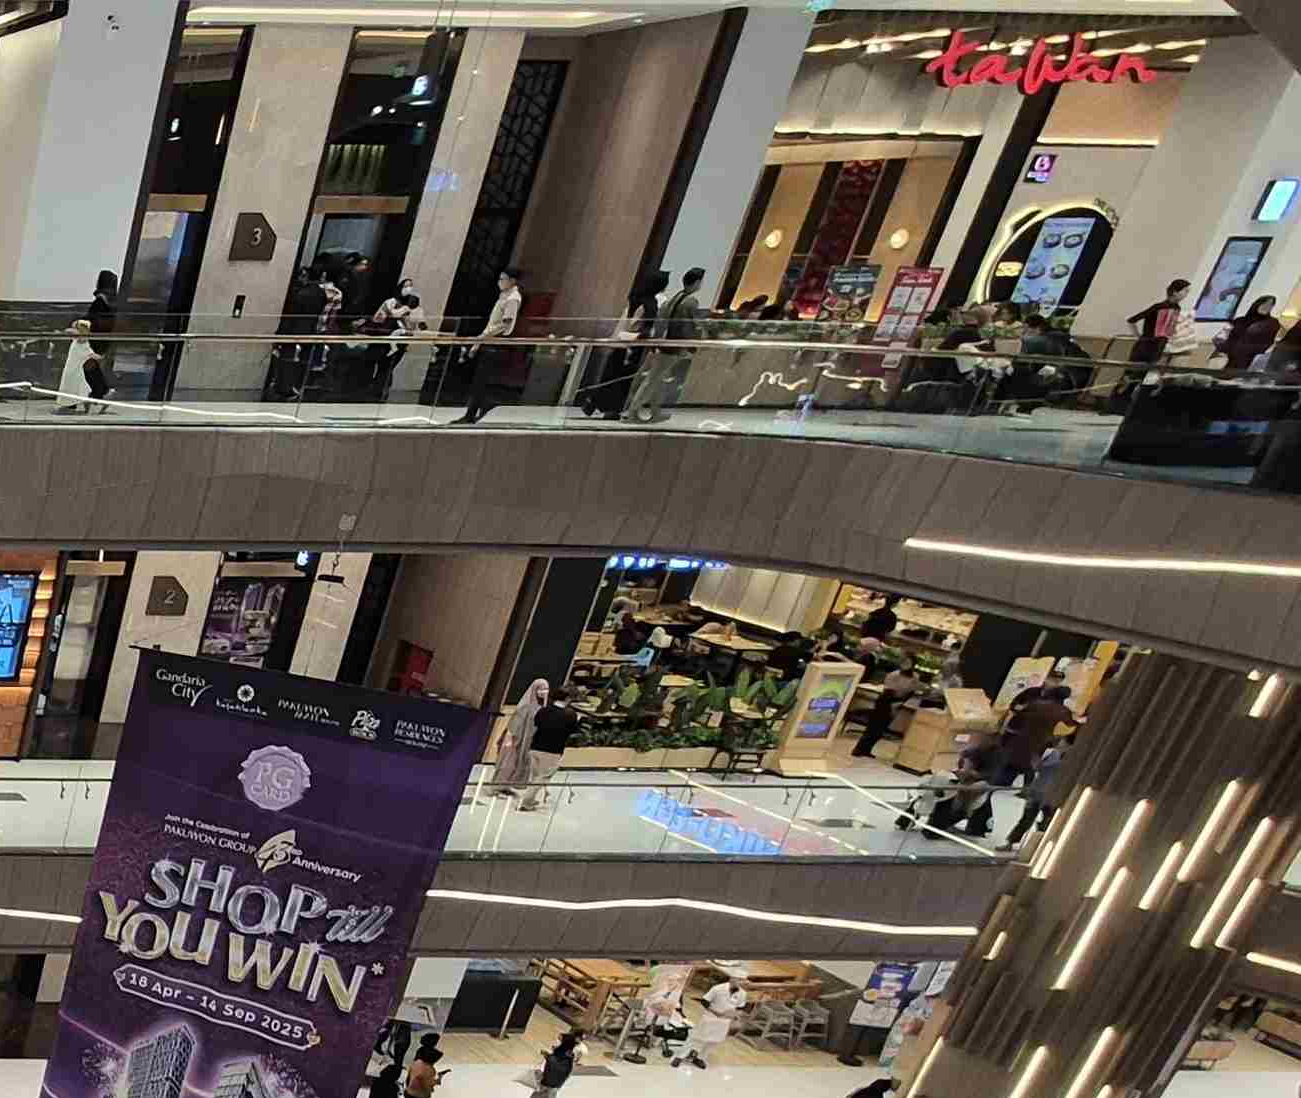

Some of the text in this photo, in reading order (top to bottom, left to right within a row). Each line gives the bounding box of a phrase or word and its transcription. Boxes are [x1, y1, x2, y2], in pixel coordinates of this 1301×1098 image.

[251, 227, 262, 246] 3
[164, 590, 175, 604] 2
[156, 668, 205, 687] Gandaria
[172, 683, 213, 707] City
[257, 762, 296, 789] PG
[250, 784, 291, 801] CARD
[292, 856, 361, 883] Anniversary
[144, 858, 328, 935] SHOP
[98, 890, 220, 966] YOU
[128, 972, 149, 989] 18
[150, 981, 182, 1002] Apr
[199, 995, 217, 1012] 14
[222, 1003, 255, 1024] Sep
[260, 1014, 304, 1040] 2025
